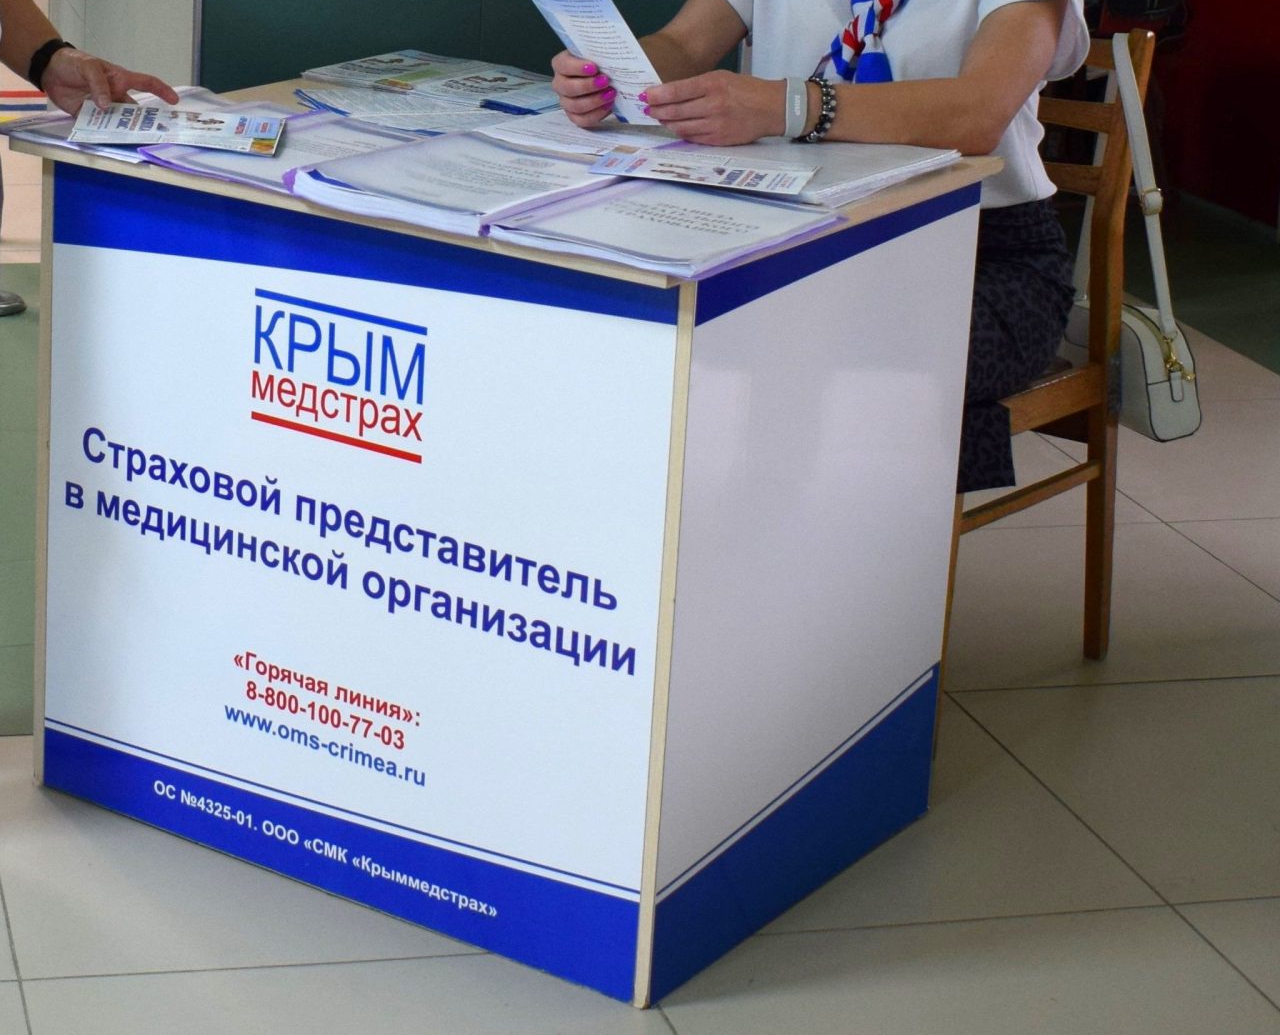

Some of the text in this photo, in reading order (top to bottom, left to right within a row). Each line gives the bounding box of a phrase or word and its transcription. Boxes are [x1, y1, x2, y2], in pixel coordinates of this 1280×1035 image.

[252, 303, 427, 406] КРЫМ
[251, 369, 423, 443] медстрах
[82, 426, 618, 612] Страховой представитель
[65, 480, 638, 677] в медицинской организации
[233, 650, 422, 728] «Горячая линия»:
[246, 680, 406, 751] 8-800-100-77-03
[224, 704, 426, 788] www.oms-crimea.ru
[154, 780, 498, 919] ОС №4325-01. ООО «СМК «Крыммедстрах»
